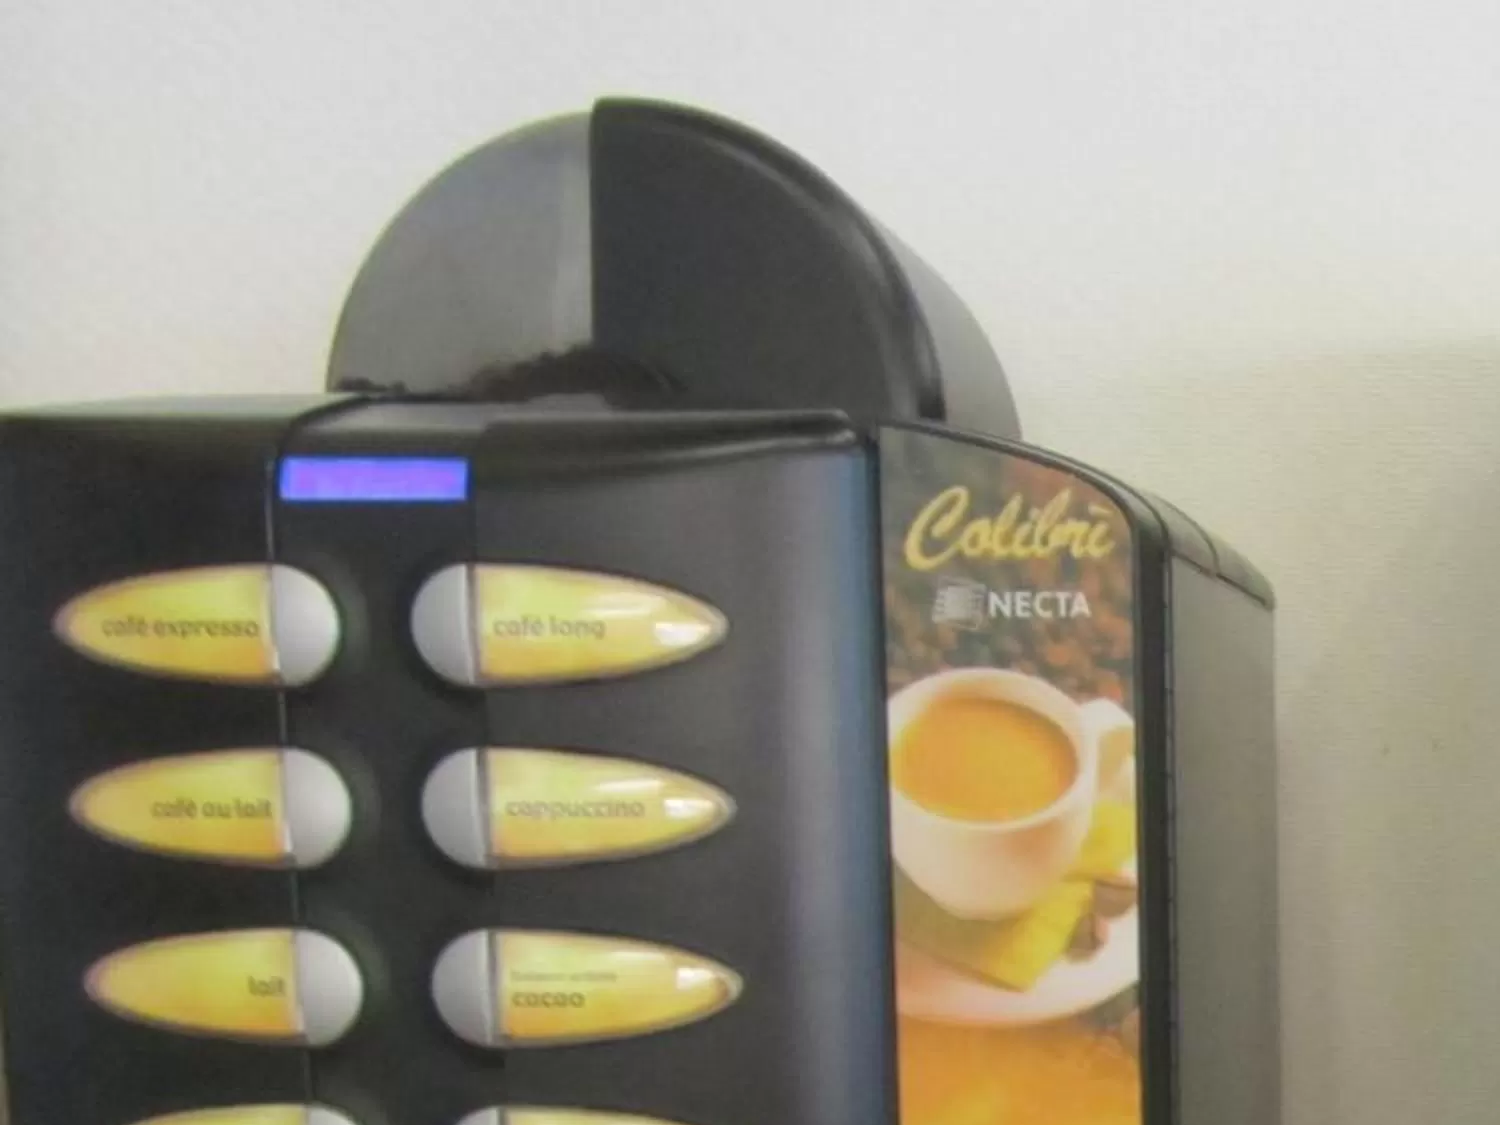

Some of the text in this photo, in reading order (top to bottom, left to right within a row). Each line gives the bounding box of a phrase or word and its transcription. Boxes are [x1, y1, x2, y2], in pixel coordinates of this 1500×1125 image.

[986, 590, 1093, 619] NECTA
[102, 614, 259, 641] café expresso
[493, 613, 607, 640] café long
[151, 796, 272, 818] café au lait
[505, 799, 645, 820] cappuccino
[247, 974, 285, 997] lait
[511, 990, 586, 1009] cacao
